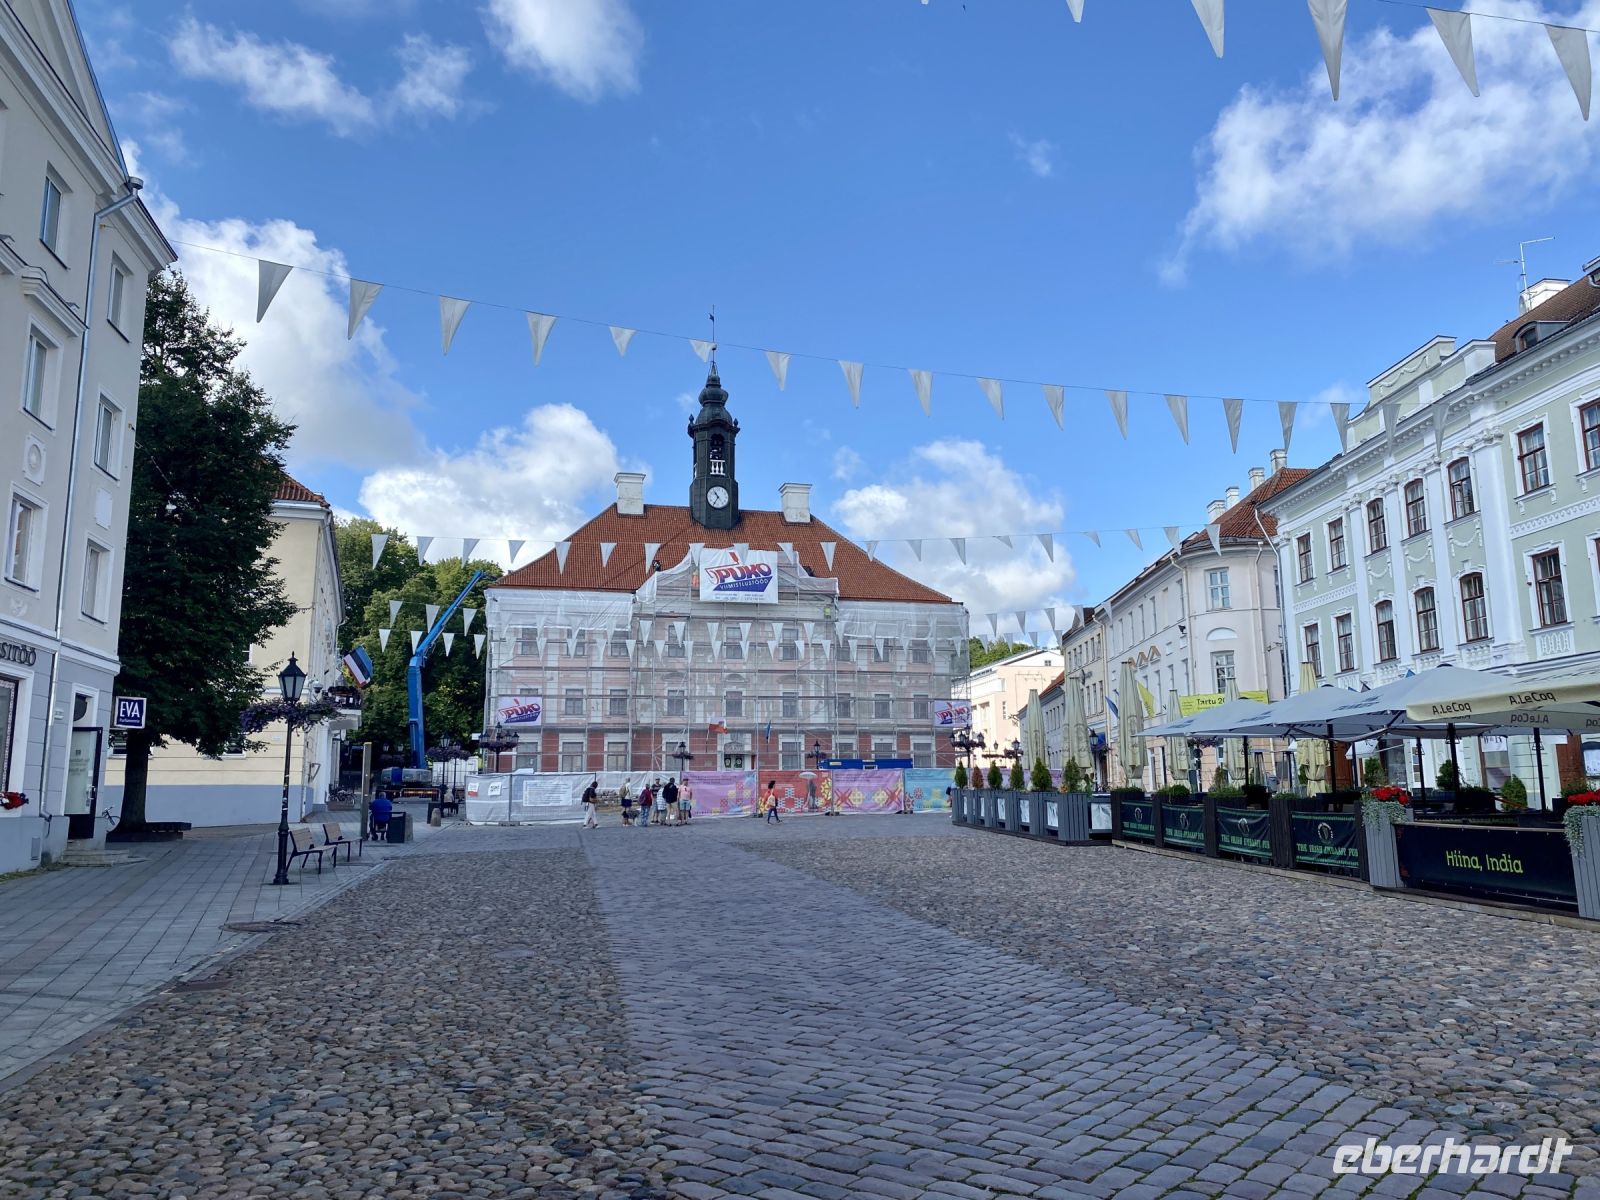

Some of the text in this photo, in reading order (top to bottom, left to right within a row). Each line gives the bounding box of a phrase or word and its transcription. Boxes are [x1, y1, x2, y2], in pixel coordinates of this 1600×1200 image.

[715, 563, 772, 584] PUKO
[1508, 692, 1557, 705] A.LeCoq
[119, 701, 140, 718] EVA
[1432, 702, 1472, 716] A.LeCoq
[1296, 842, 1308, 852] THE
[1446, 850, 1524, 874] Hiina, India
